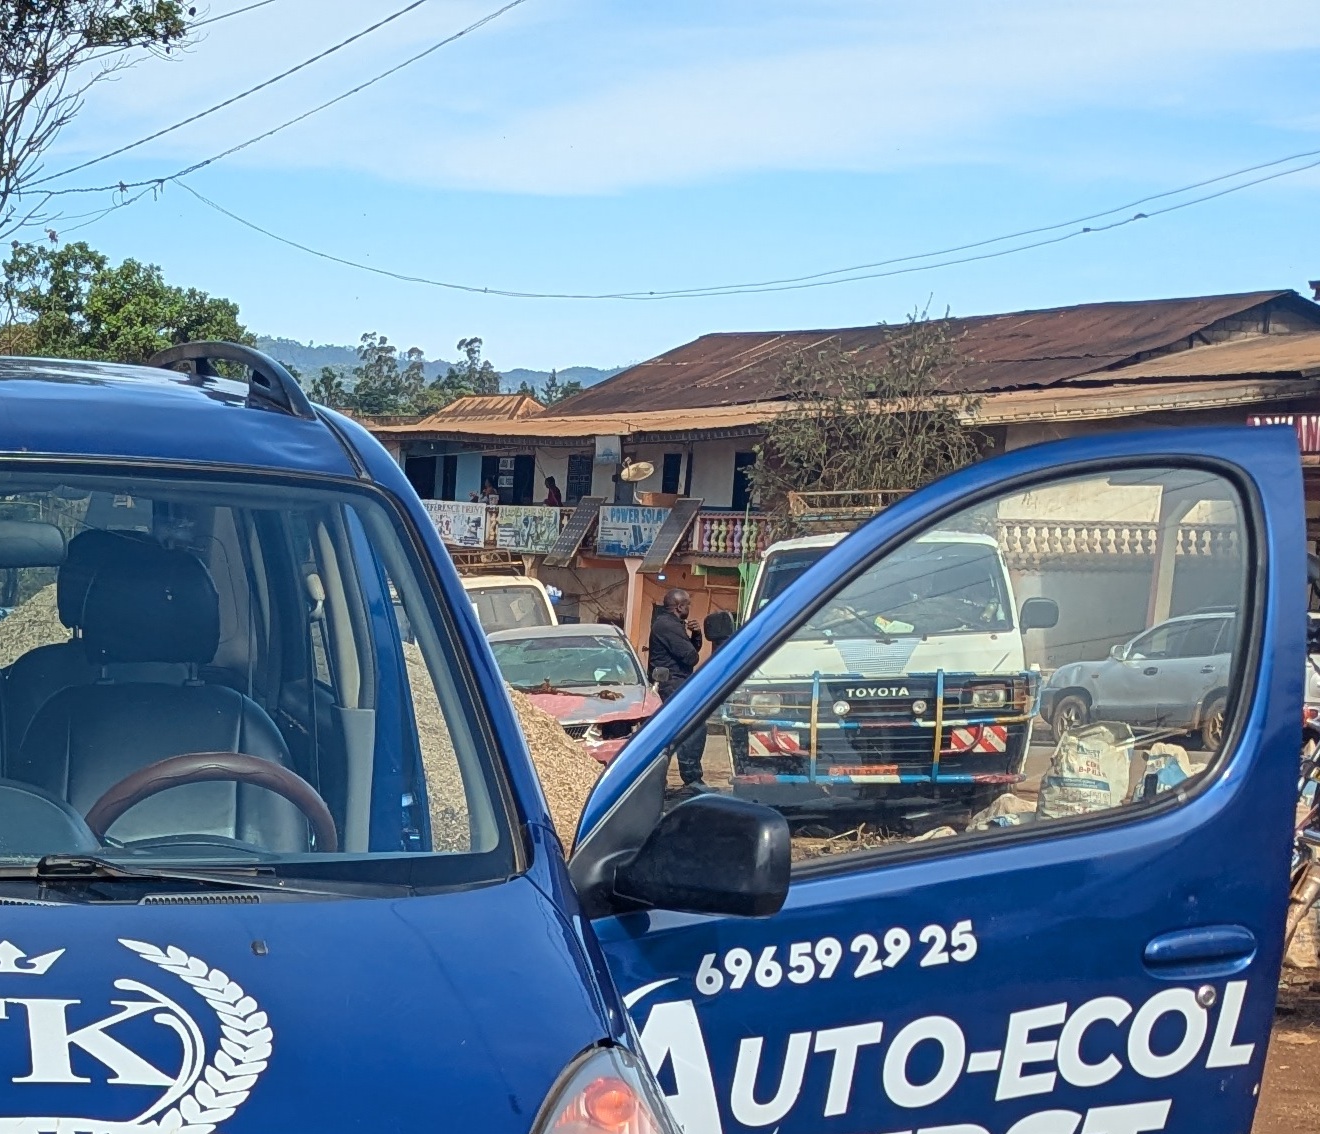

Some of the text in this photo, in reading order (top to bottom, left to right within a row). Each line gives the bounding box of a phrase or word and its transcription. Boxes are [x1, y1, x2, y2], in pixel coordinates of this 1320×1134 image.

[610, 507, 639, 524] POWER
[846, 687, 909, 697] TOYOTA
[851, 928, 910, 979] 29
[919, 920, 977, 968] 25
